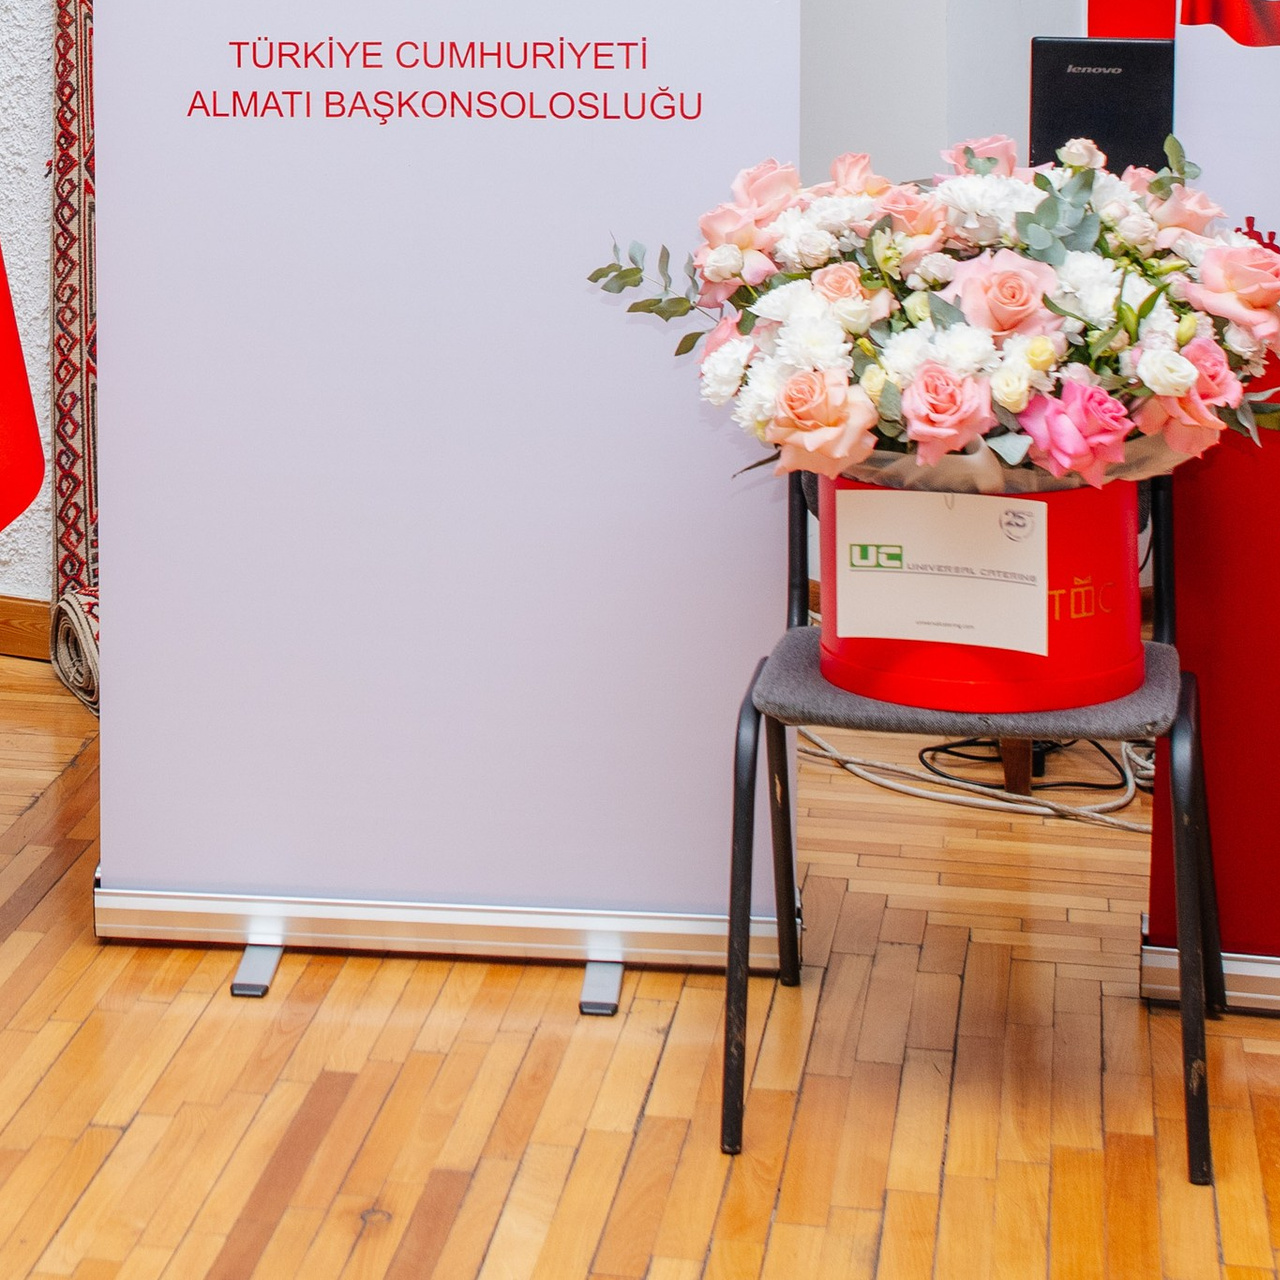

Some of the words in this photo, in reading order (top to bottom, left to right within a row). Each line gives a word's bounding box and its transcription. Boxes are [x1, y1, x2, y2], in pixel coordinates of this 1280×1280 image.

[228, 36, 383, 70] TÜRKİYE
[394, 36, 649, 71] CUMHURİYETİ
[1066, 64, 1122, 75] lenovo
[186, 90, 312, 118] ALMATI
[323, 86, 704, 125] BAŞKONSOLOSLUĞU
[850, 544, 903, 569] UC
[906, 563, 976, 576] UNIVERSAL
[979, 568, 1037, 583] CATERING
